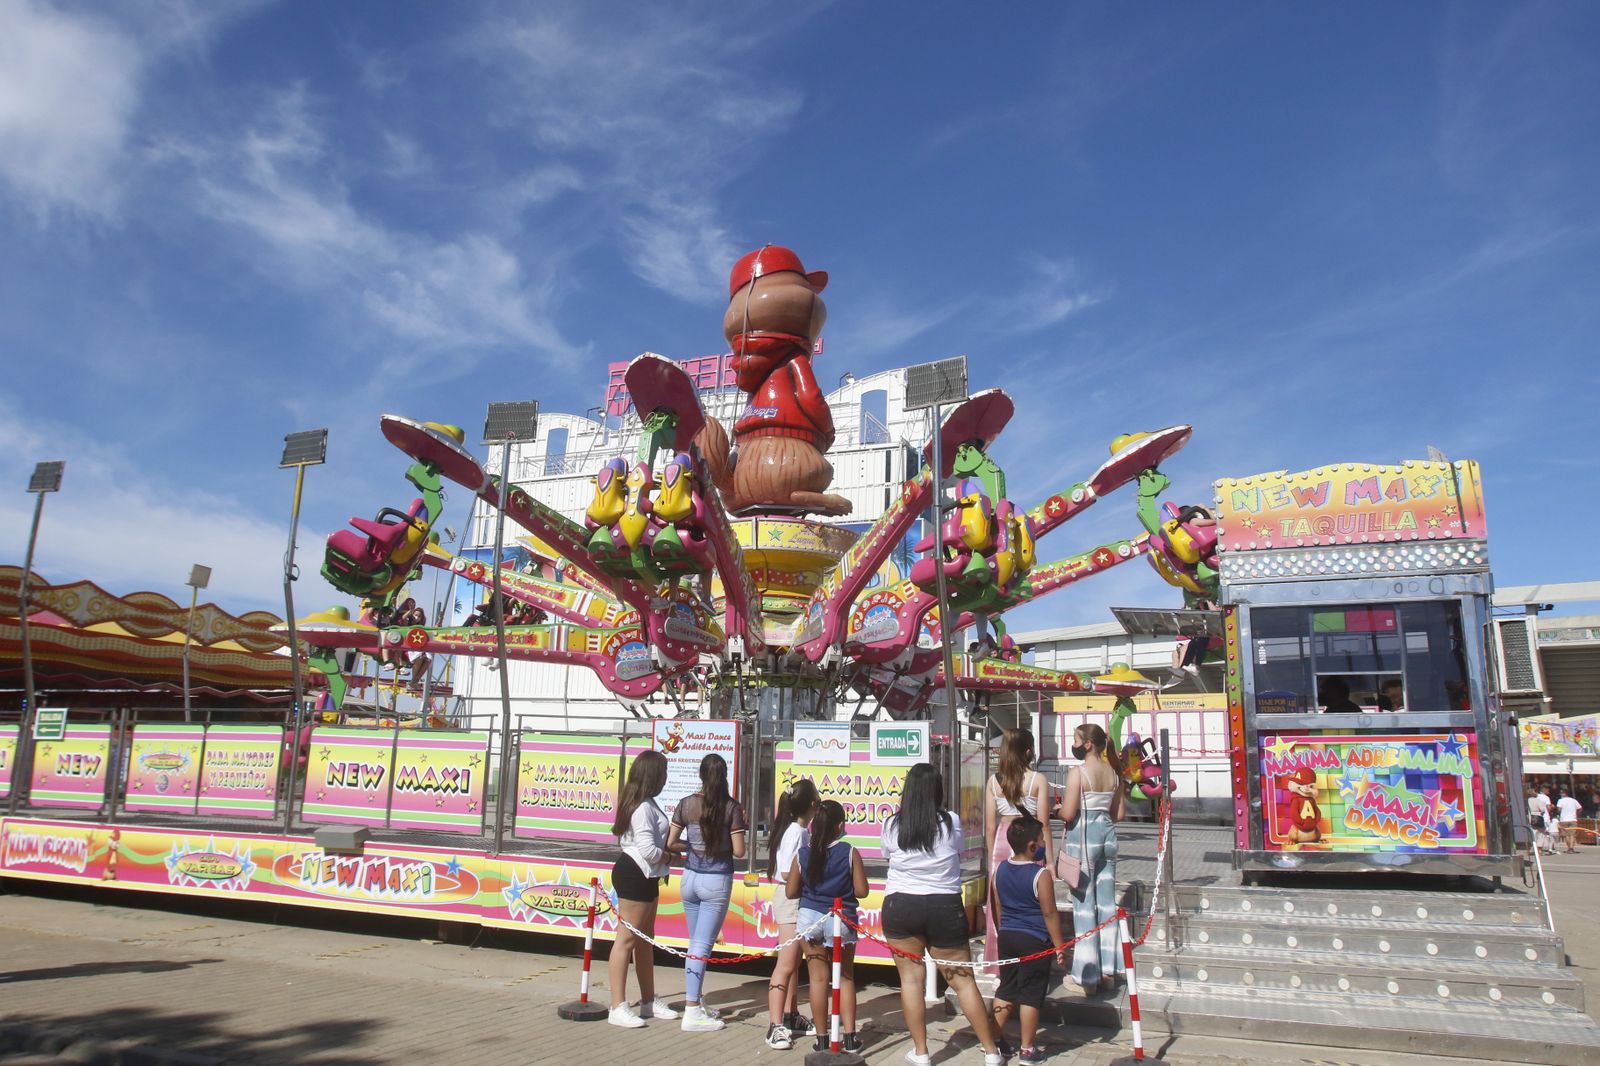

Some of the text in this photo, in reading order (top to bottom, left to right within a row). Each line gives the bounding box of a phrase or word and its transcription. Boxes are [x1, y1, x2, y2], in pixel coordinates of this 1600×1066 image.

[1232, 481, 1332, 513] NEW
[1280, 510, 1418, 538] TAQUILLA
[682, 743, 734, 752] Ardilla Alvin
[685, 732, 731, 740] Maxi Dance
[878, 737, 907, 750] ENTRADA
[56, 753, 101, 776] NEW
[1346, 748, 1473, 777] ADRENALINA
[327, 762, 471, 795] NEW MAXI
[534, 764, 600, 785] MAXIMA
[521, 787, 613, 811] ADRENALINA
[1300, 800, 1316, 819] A
[1362, 791, 1432, 826] MAXI
[1344, 807, 1440, 847] DANCE
[182, 862, 236, 876] VARGAS
[302, 857, 360, 889] NEW
[551, 888, 580, 898] GRUPO
